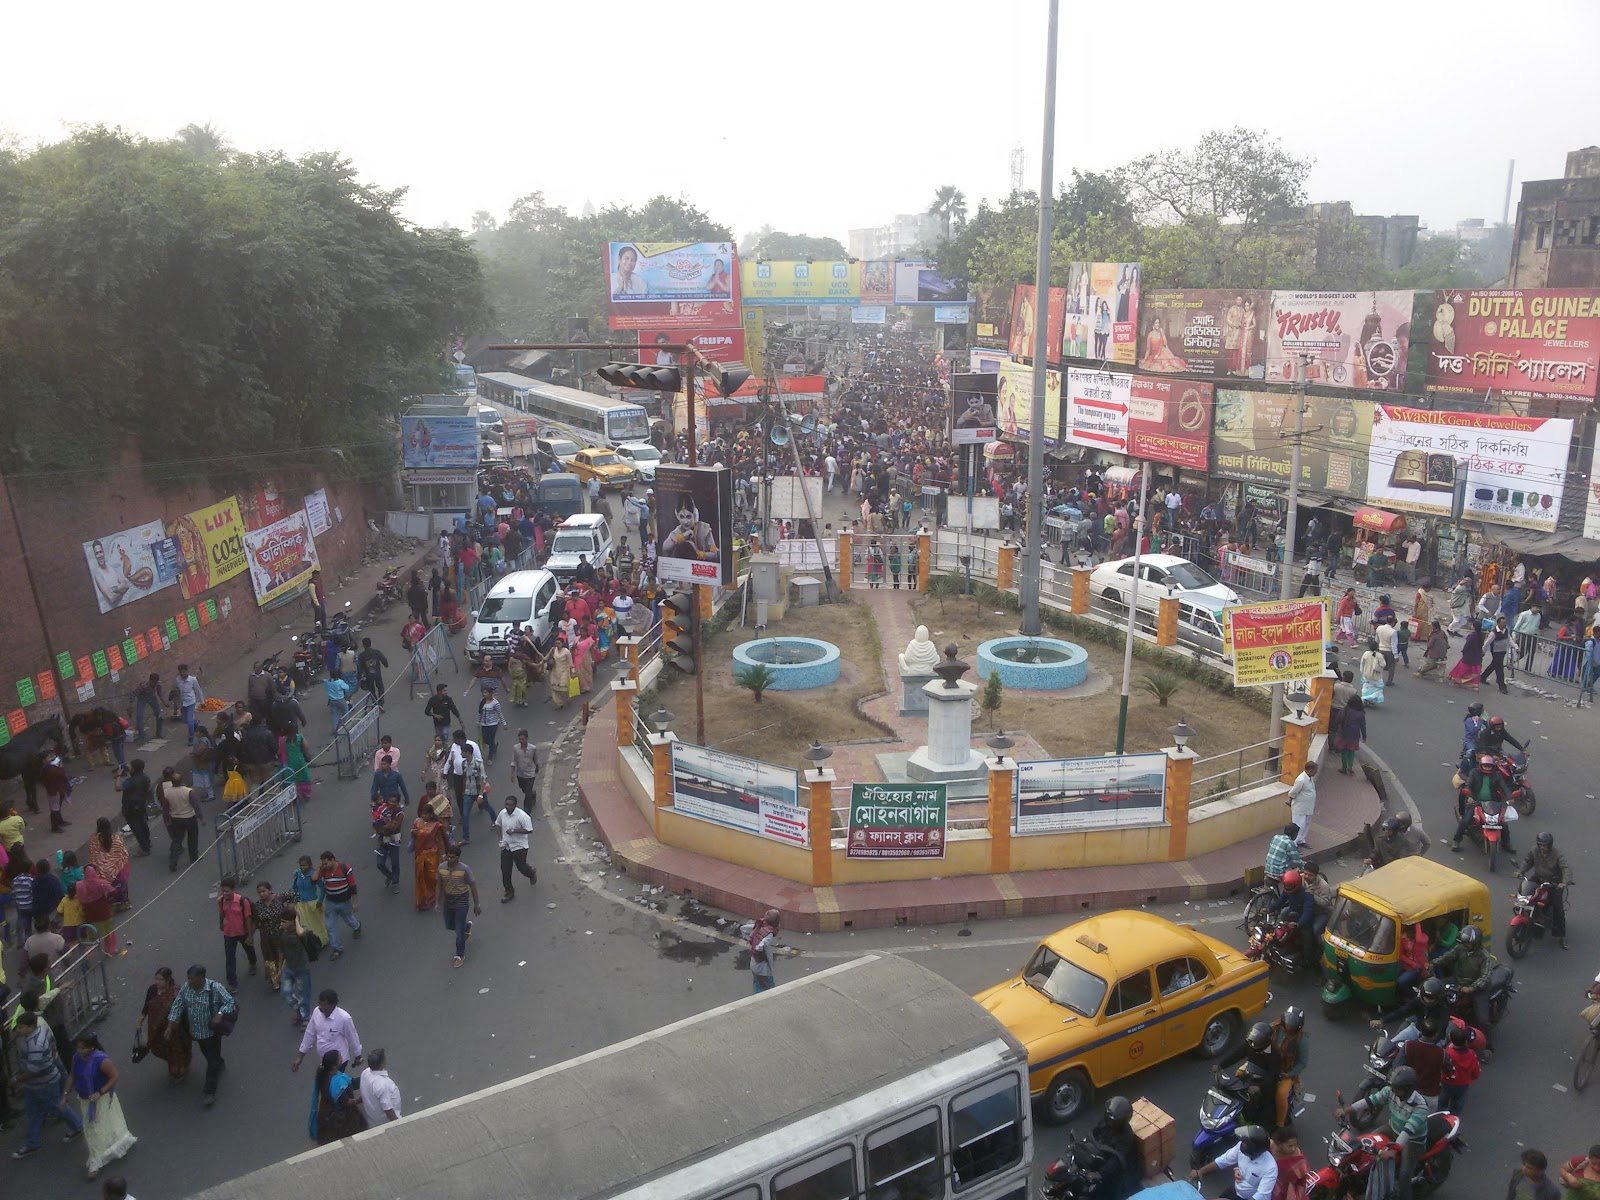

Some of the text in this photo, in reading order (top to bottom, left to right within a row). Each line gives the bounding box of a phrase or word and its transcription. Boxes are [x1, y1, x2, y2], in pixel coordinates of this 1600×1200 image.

[1468, 297, 1600, 318] DUTTA GUINEA
[1192, 315, 1215, 325] আদি
[1499, 319, 1569, 339] PALACE
[698, 336, 733, 345] RUPA
[1543, 340, 1589, 348] JEWELLERS
[1471, 349, 1518, 378] গিনি
[1518, 358, 1594, 382] প্যালেস
[1392, 408, 1533, 431] Swastik Gem & Jewellers
[1439, 434, 1470, 451] সঠিক
[1476, 437, 1529, 457] দিকনির্ণয়
[203, 509, 234, 533] LUX
[211, 525, 243, 565] cozi
[1234, 616, 1321, 645] লাল-হলুদ পরিবার
[862, 786, 938, 804] ঐতিহ্যের নাম
[855, 803, 941, 826] মোহনবাগান
[903, 831, 925, 844] ক্লাব
